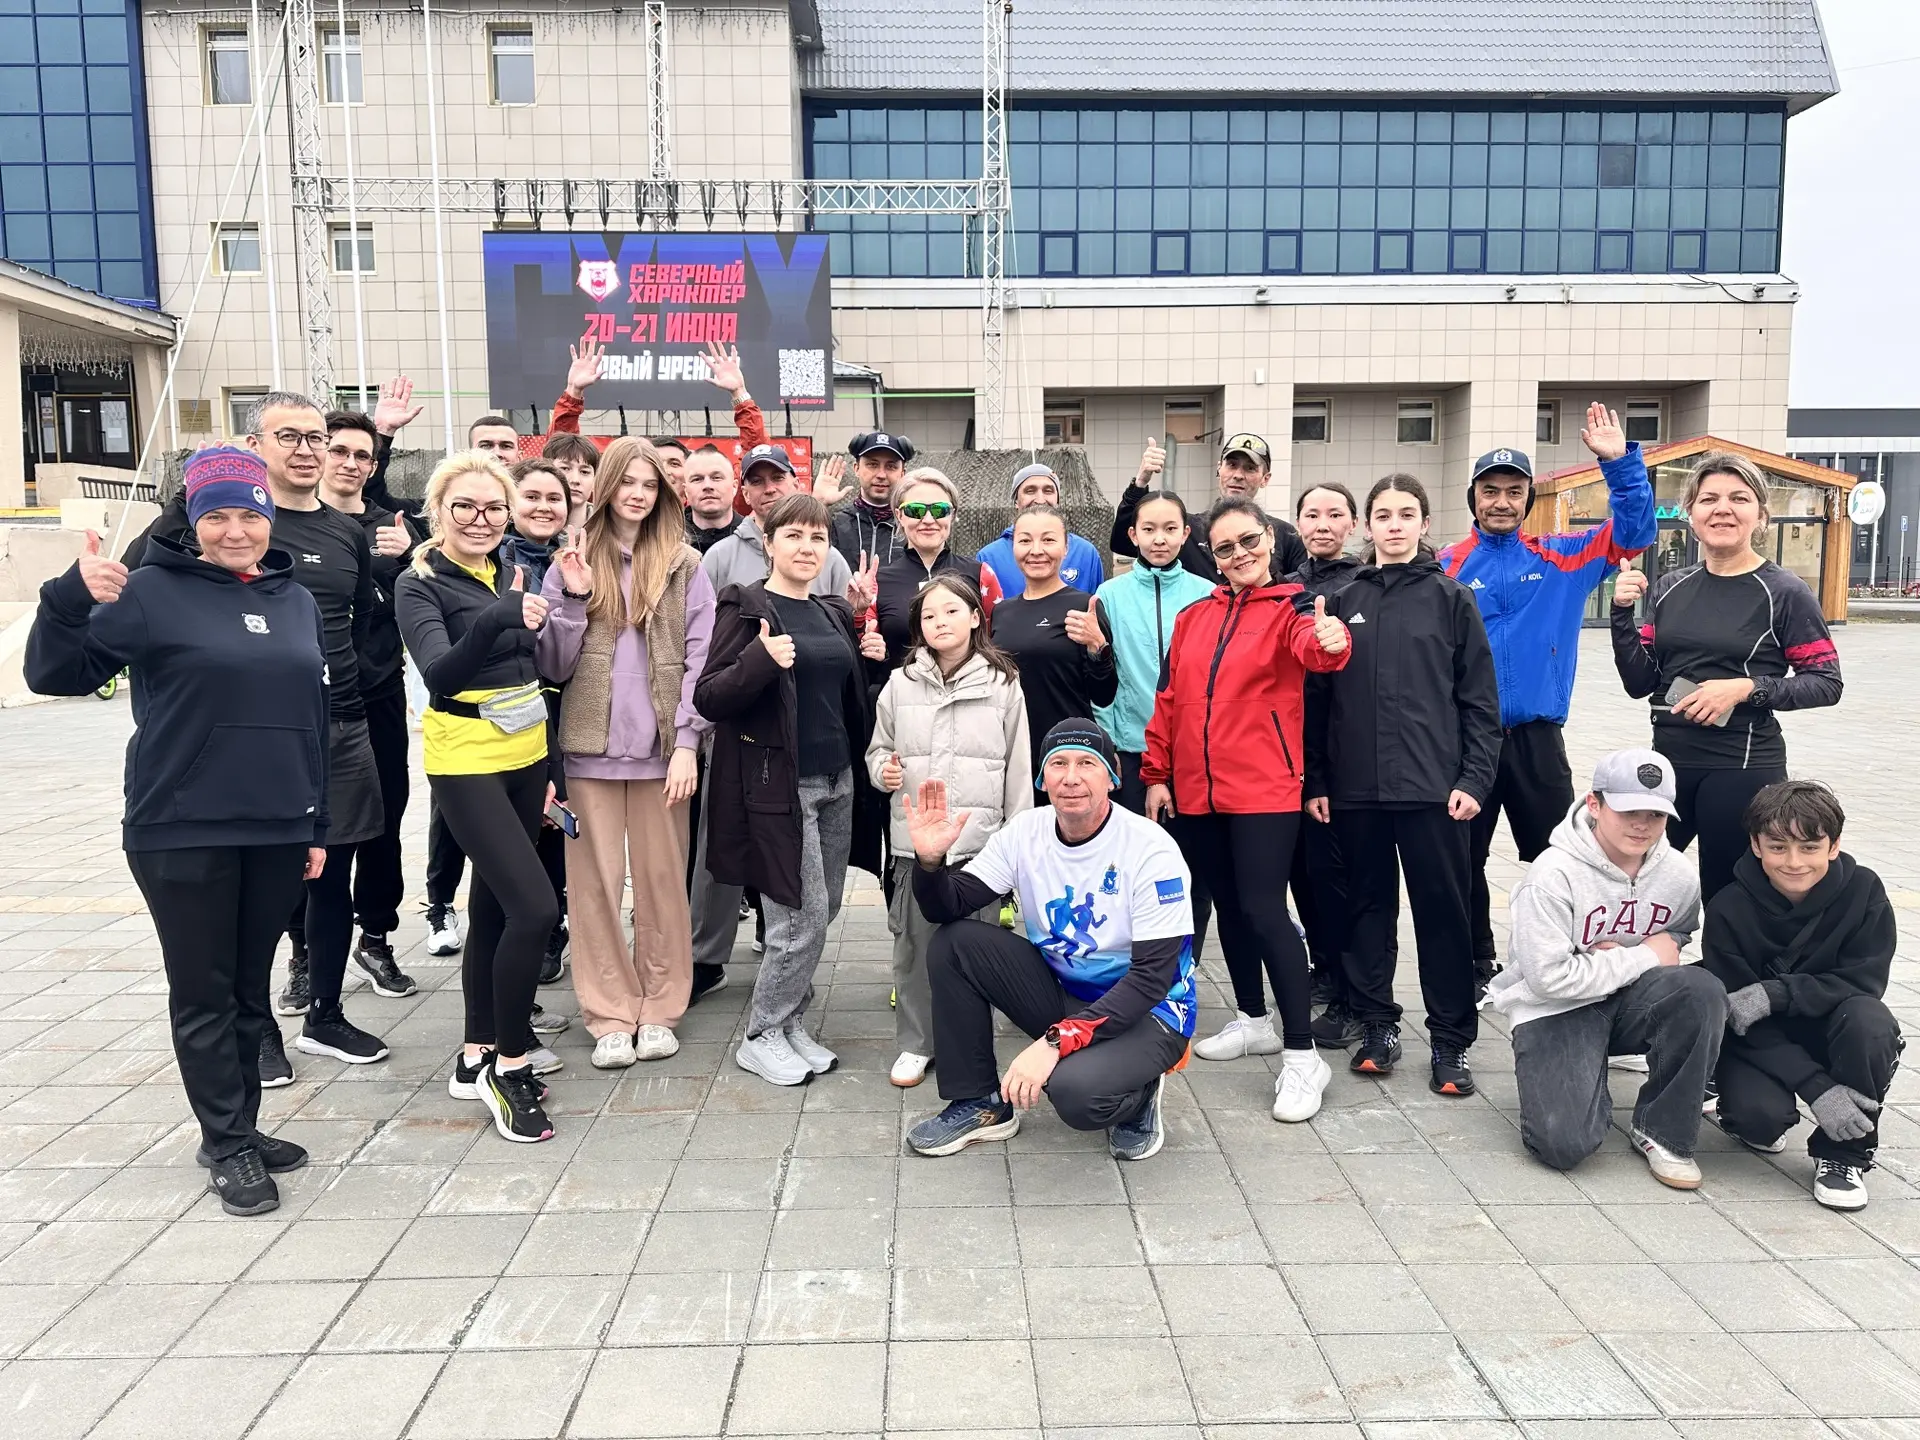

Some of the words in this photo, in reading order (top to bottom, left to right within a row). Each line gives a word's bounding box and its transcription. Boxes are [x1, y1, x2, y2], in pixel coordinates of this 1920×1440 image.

[629, 259, 745, 284] СЕВЕРНЫЙ
[626, 284, 747, 304] ХАРАКТЕР
[665, 312, 739, 343] ИЮНЯ
[592, 349, 653, 380] ОВЫЙ
[1581, 899, 1673, 946] GAP
